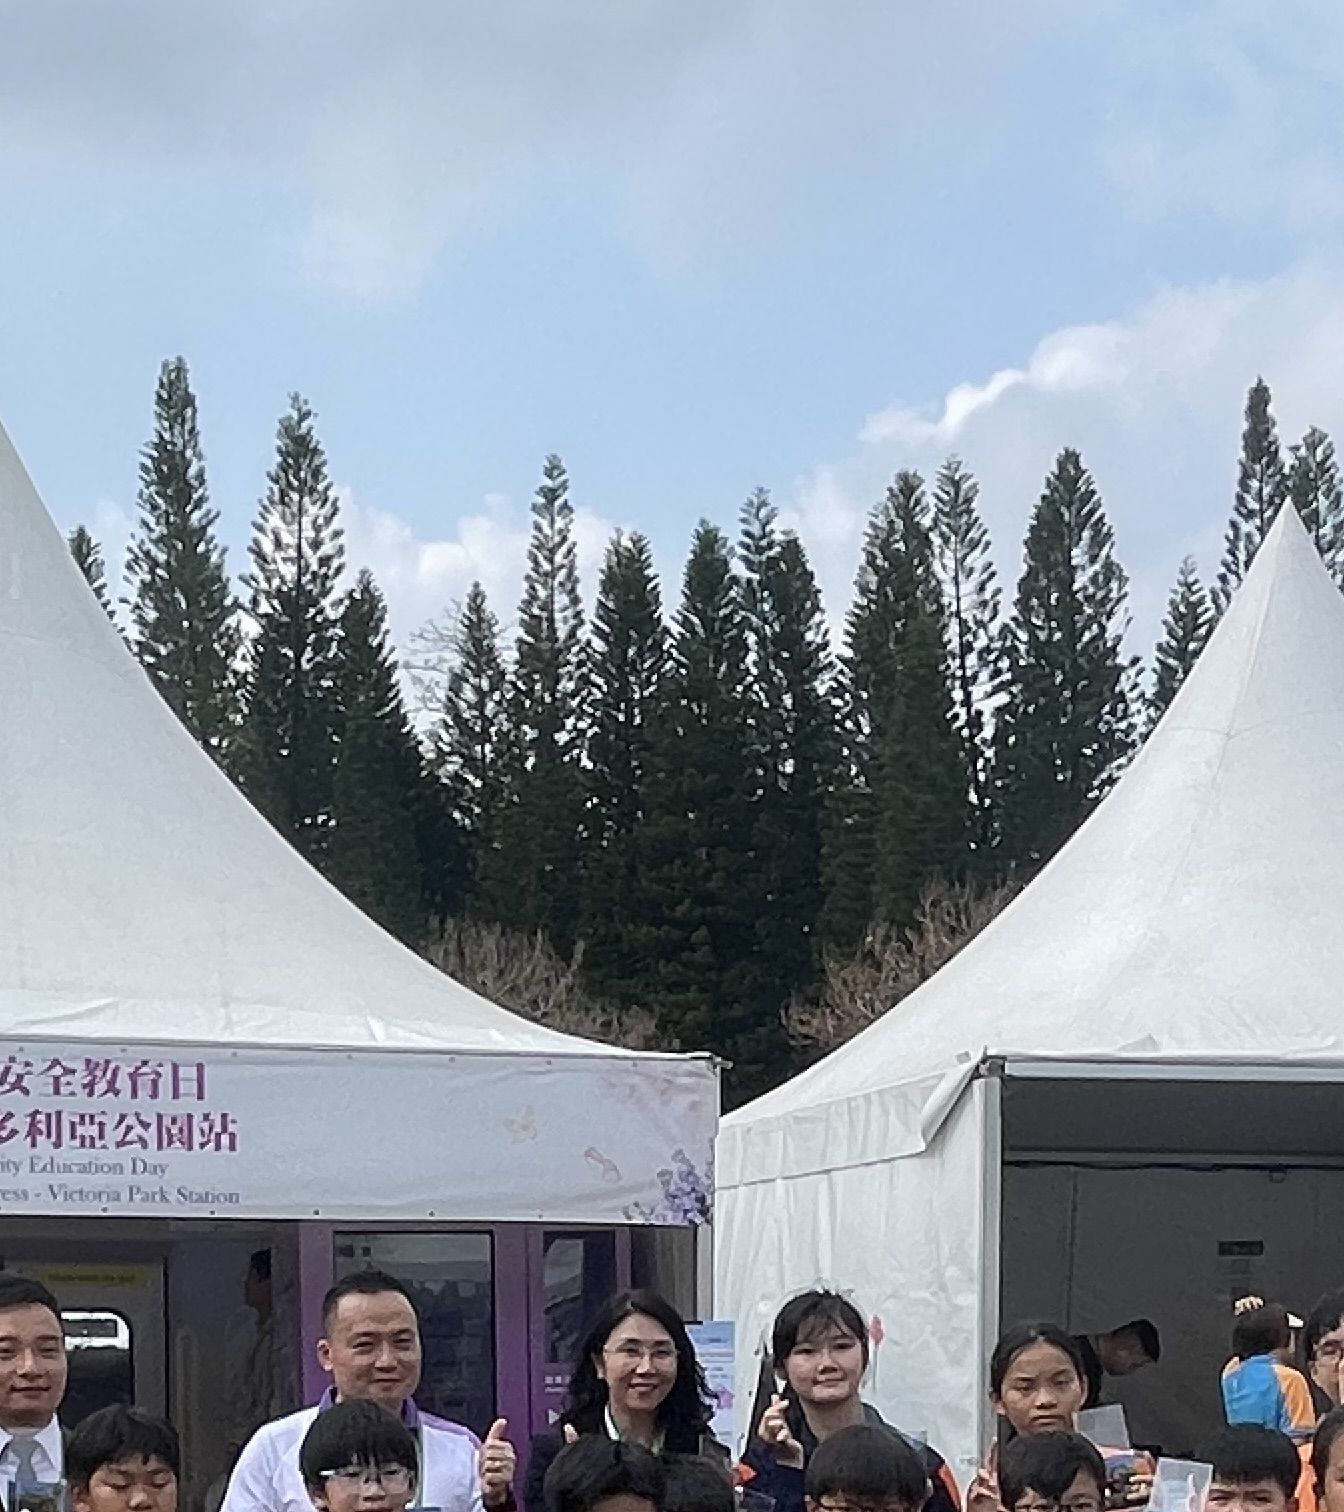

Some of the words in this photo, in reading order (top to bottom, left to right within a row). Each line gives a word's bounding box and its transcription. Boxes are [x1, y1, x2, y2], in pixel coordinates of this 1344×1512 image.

[29, 1155, 124, 1176] Education
[130, 1157, 169, 1178] Day
[48, 1183, 123, 1203] Victoria
[128, 1185, 169, 1204] Park
[175, 1186, 241, 1205] Station
